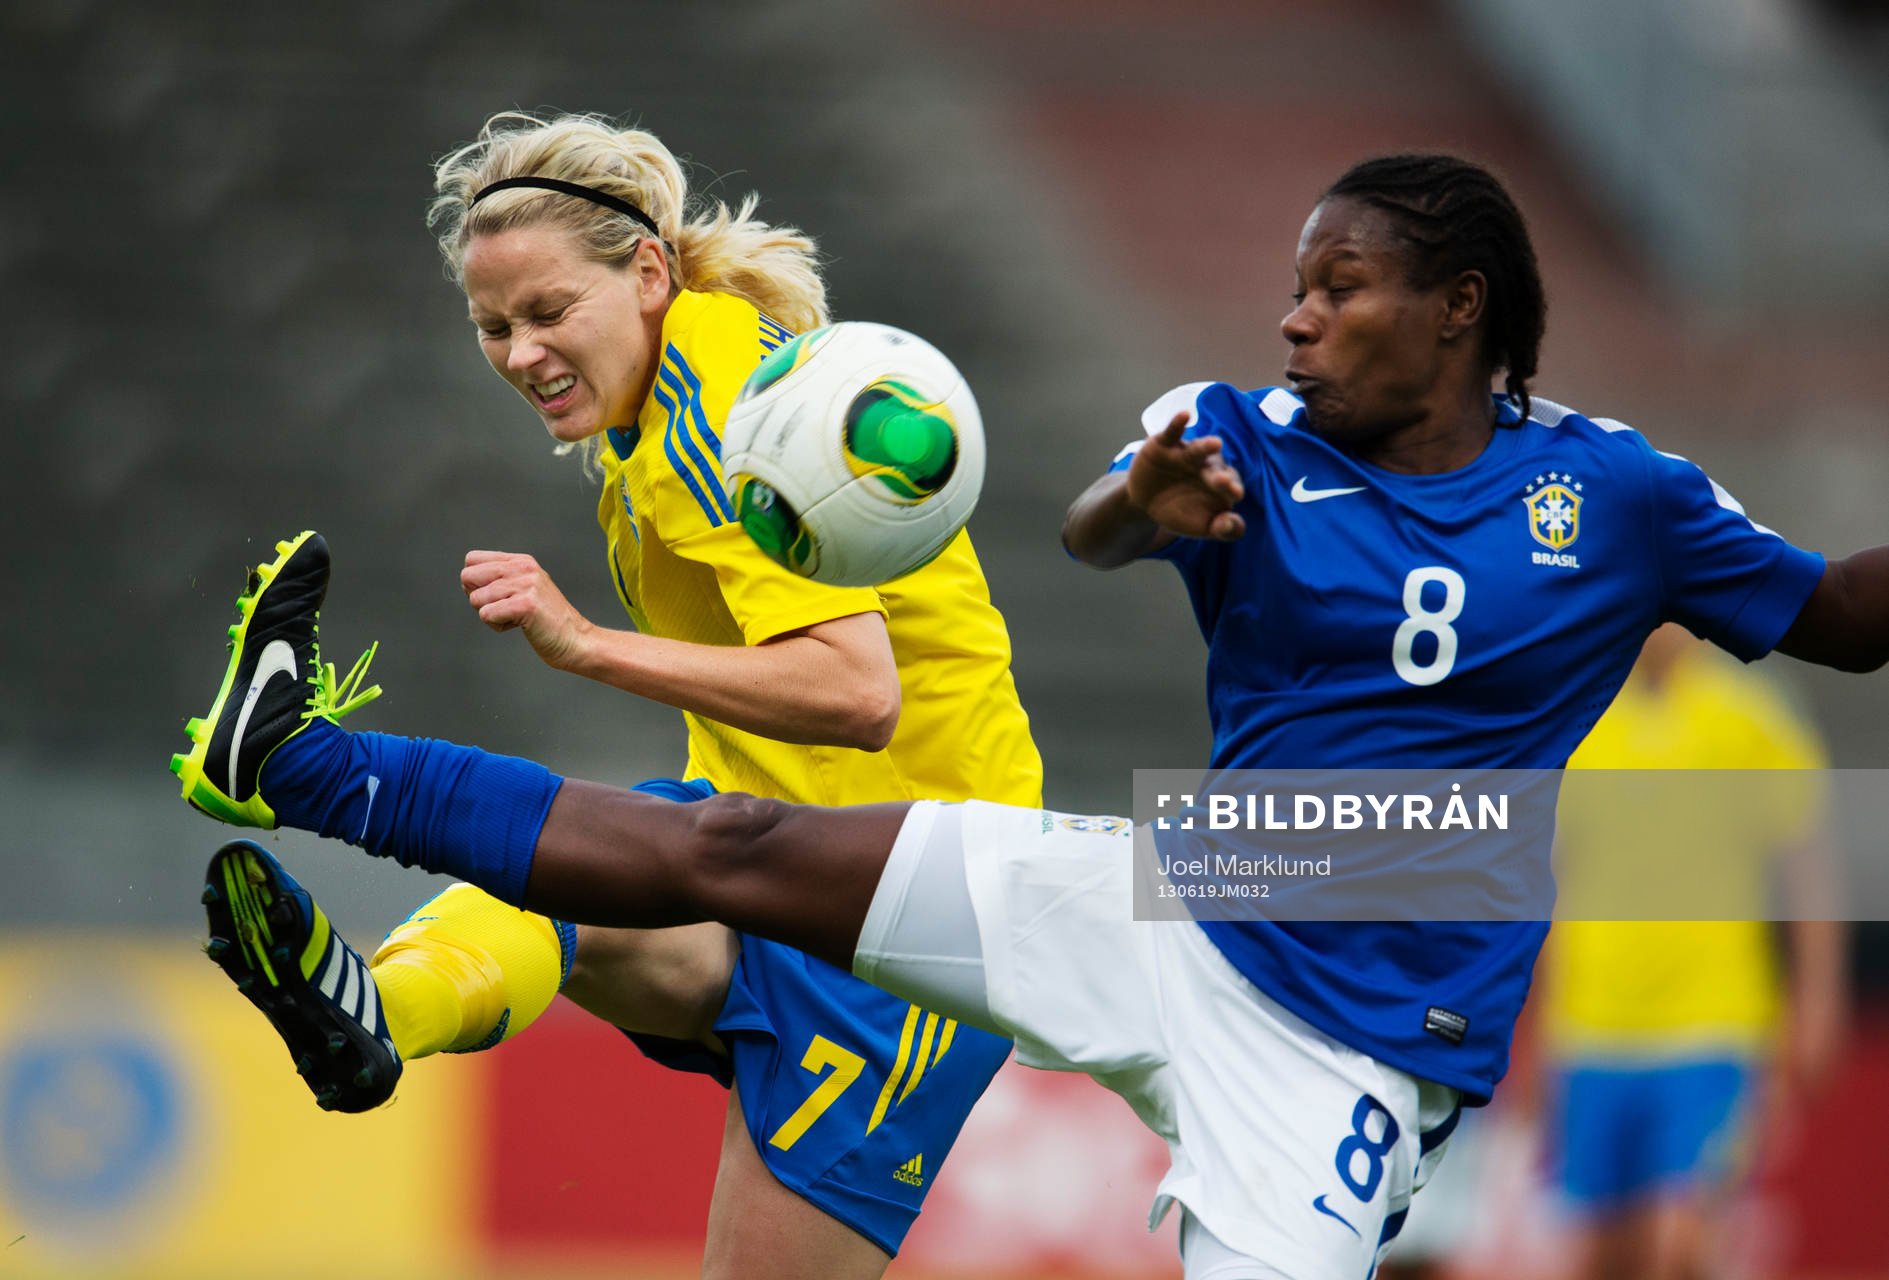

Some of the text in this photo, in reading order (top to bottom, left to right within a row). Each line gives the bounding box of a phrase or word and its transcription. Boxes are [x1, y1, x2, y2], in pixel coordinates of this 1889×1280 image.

[1531, 551, 1580, 569] BRASIL
[1392, 566, 1466, 686] 8
[768, 1033, 867, 1152] 7
[892, 1170, 924, 1187] adidas
[1335, 1093, 1400, 1203] 8
